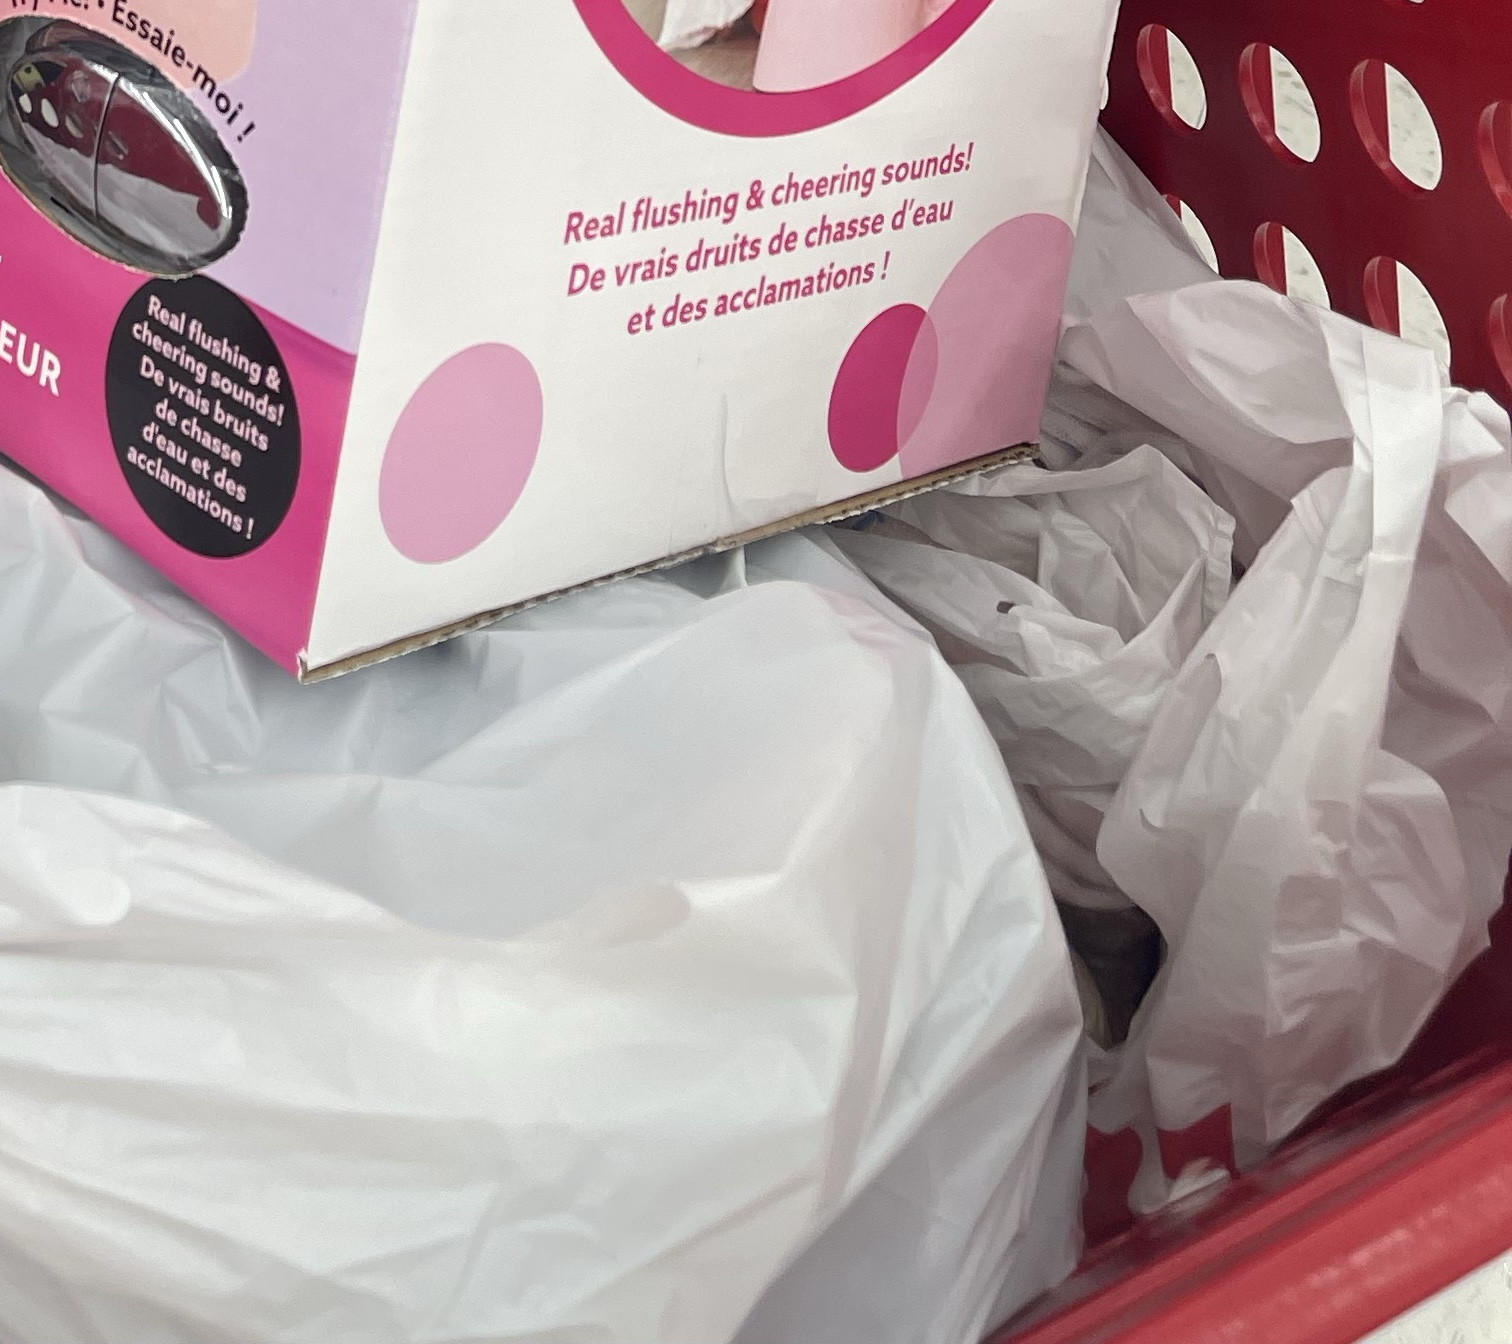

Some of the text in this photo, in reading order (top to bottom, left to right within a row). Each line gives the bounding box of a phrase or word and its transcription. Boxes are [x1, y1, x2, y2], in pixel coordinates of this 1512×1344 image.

[563, 142, 975, 245] Real flushing & cheering sounds!
[567, 198, 954, 297] De vrais druits de chasse d'eau
[147, 294, 281, 394] Real flushing &
[627, 304, 654, 336] et
[662, 295, 707, 329] des
[714, 259, 876, 318] acclamations
[132, 321, 286, 427] cheering sounds!
[139, 355, 269, 452] De vrais bruits
[142, 422, 247, 503] d'eau et des
[155, 398, 242, 468] de chasse
[127, 445, 243, 533] acclamations
